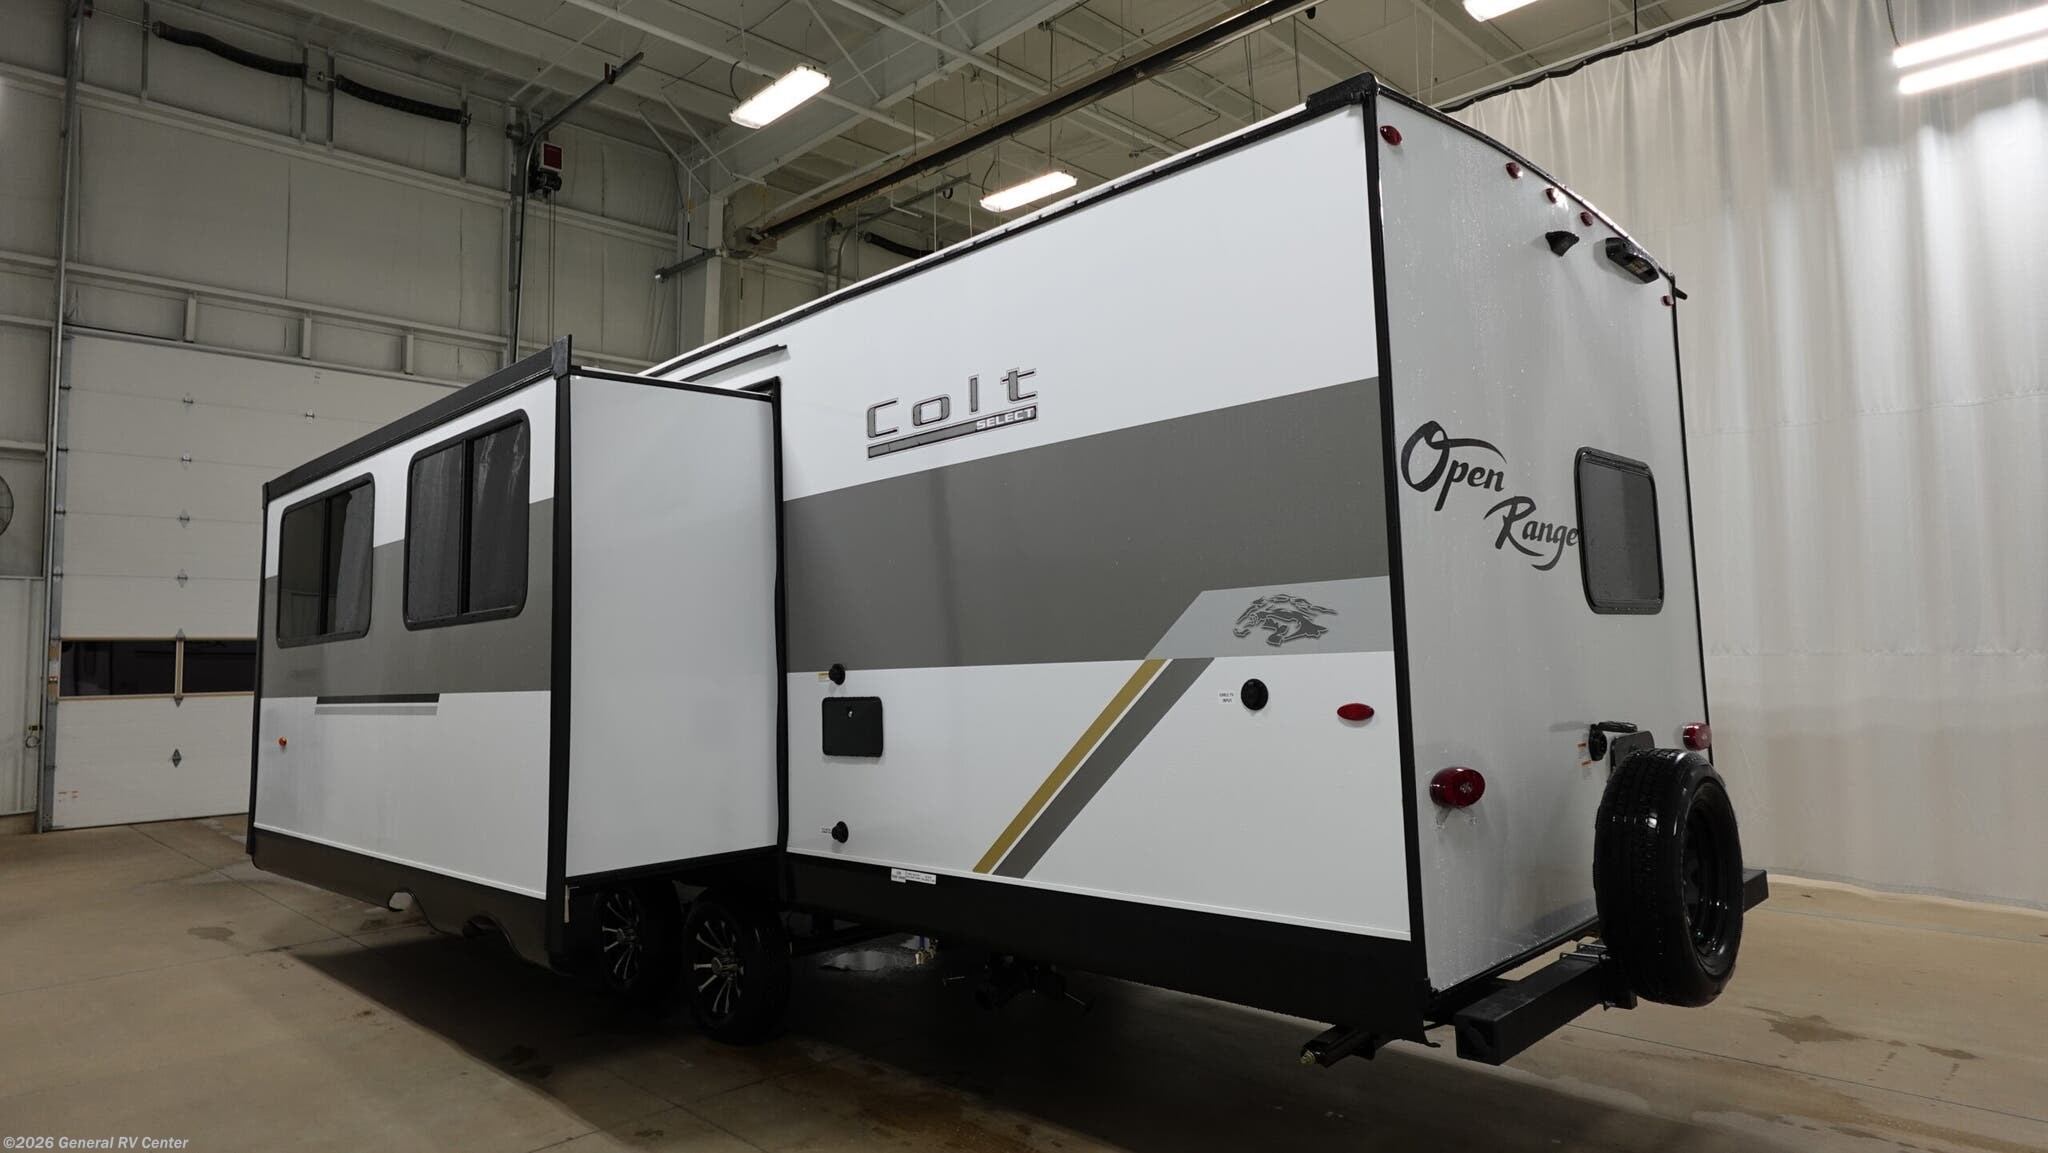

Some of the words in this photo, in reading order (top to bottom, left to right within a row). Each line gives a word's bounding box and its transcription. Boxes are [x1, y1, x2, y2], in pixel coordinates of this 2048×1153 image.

[976, 407, 1034, 431] SELECT
[1400, 420, 1507, 511] Open
[1483, 496, 1579, 571] Range
